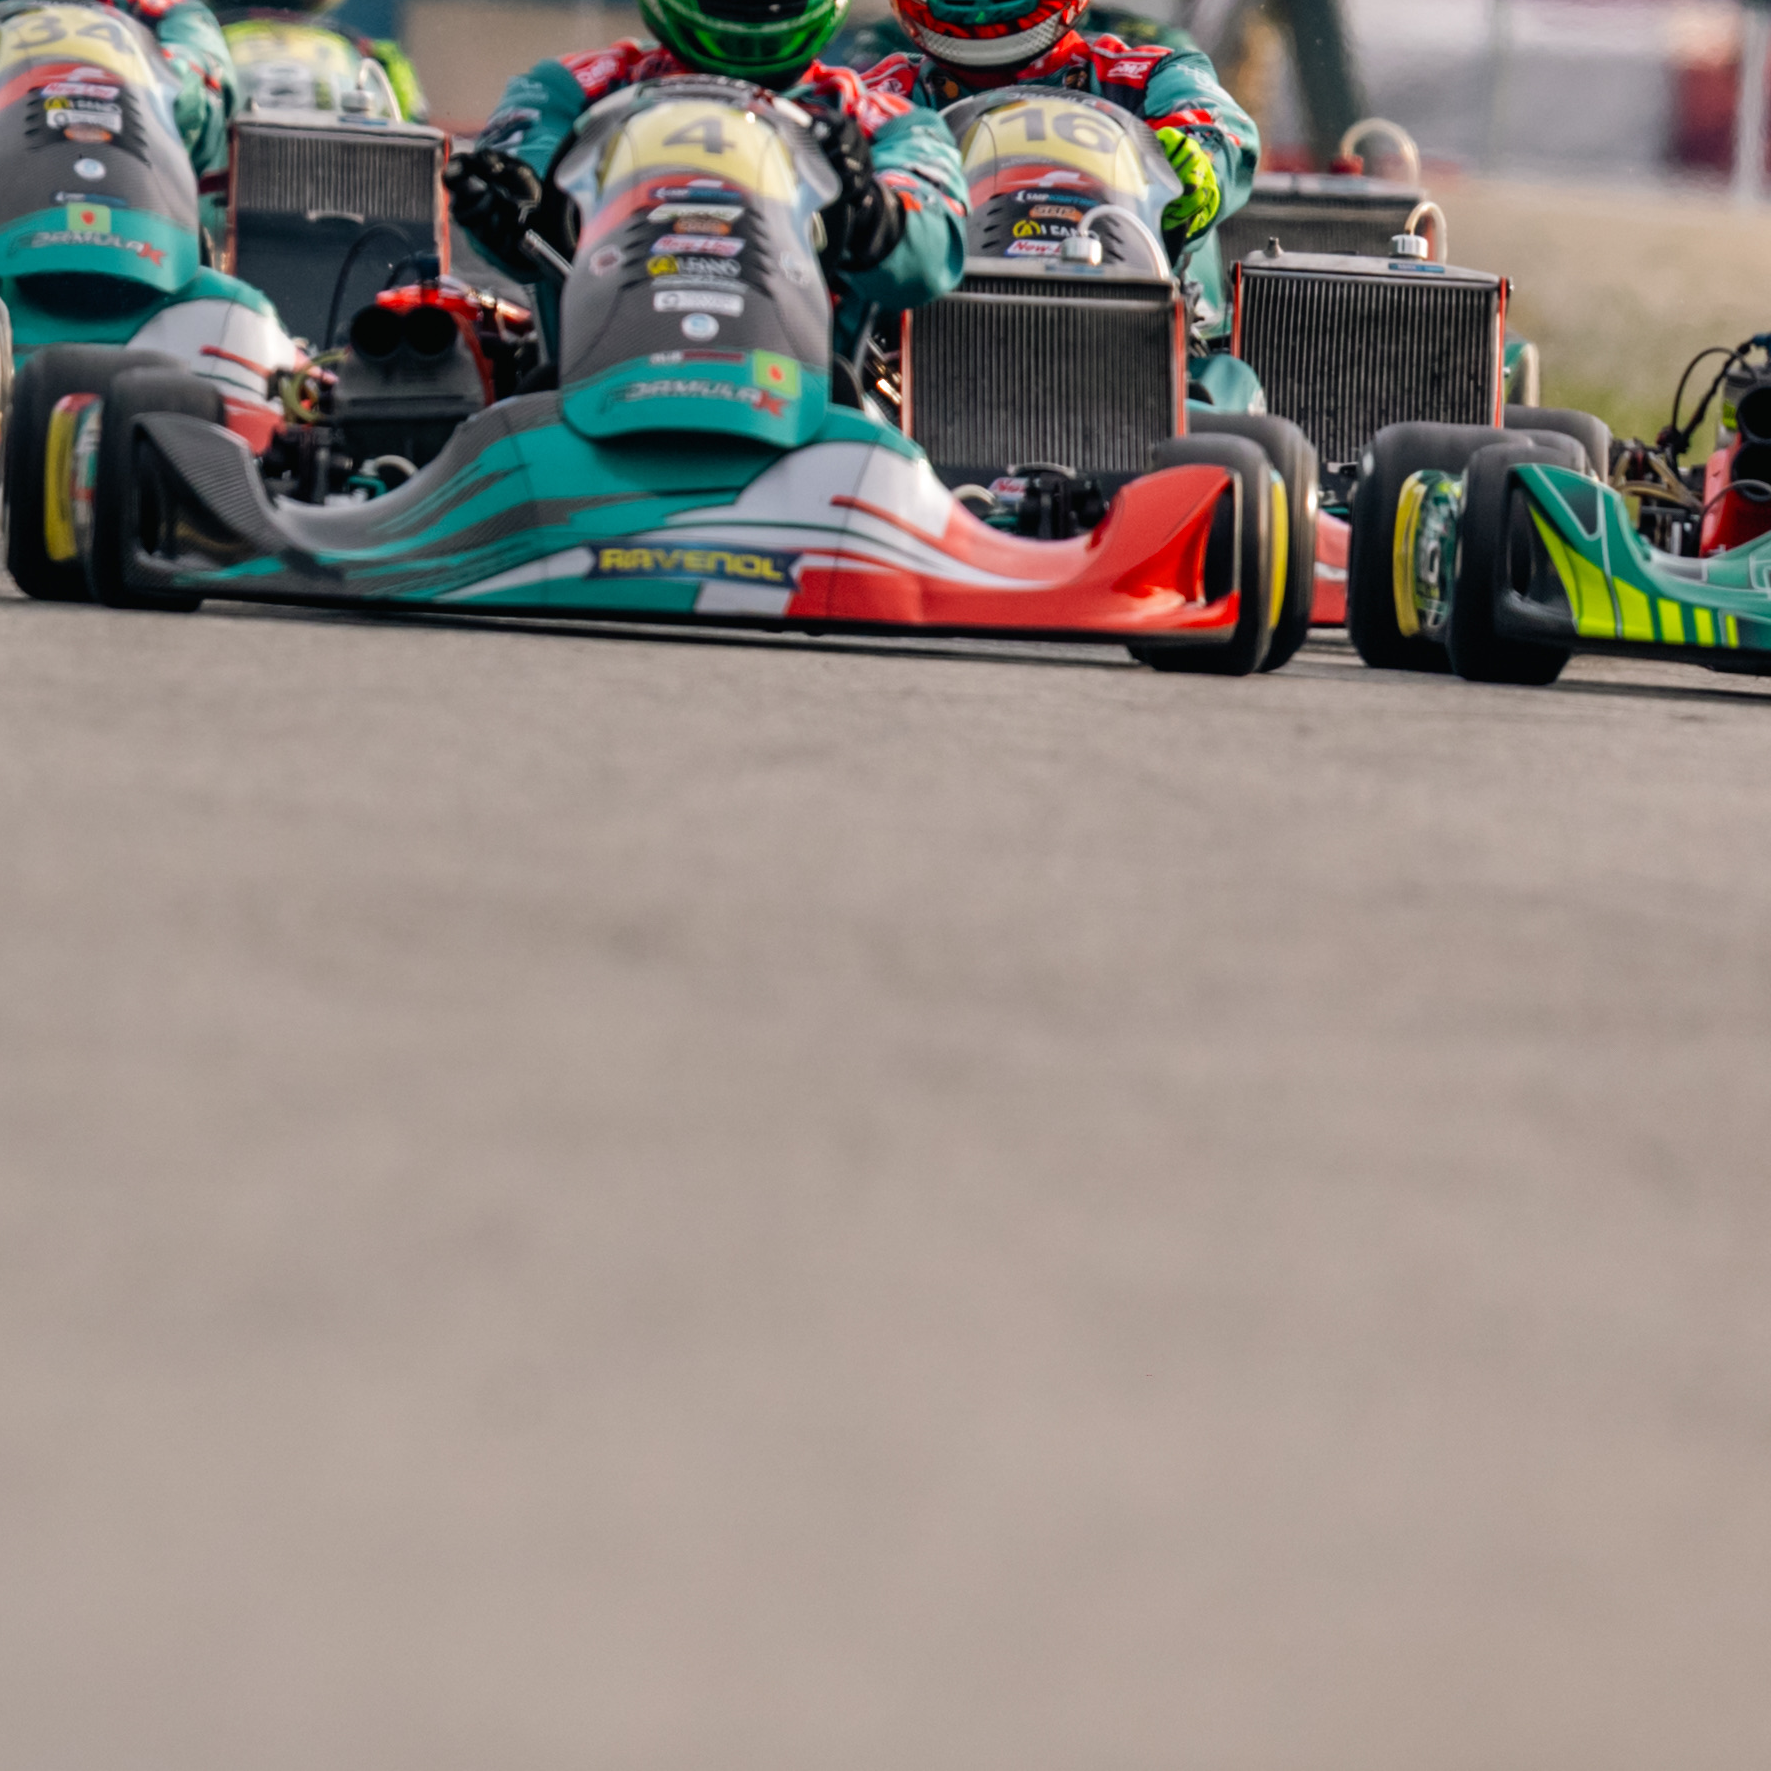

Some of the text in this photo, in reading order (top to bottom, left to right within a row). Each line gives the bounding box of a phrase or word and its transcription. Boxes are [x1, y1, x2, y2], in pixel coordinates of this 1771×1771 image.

[662, 115, 736, 155] 4
[999, 108, 1116, 154] 16
[598, 547, 785, 580] RAVENOL
